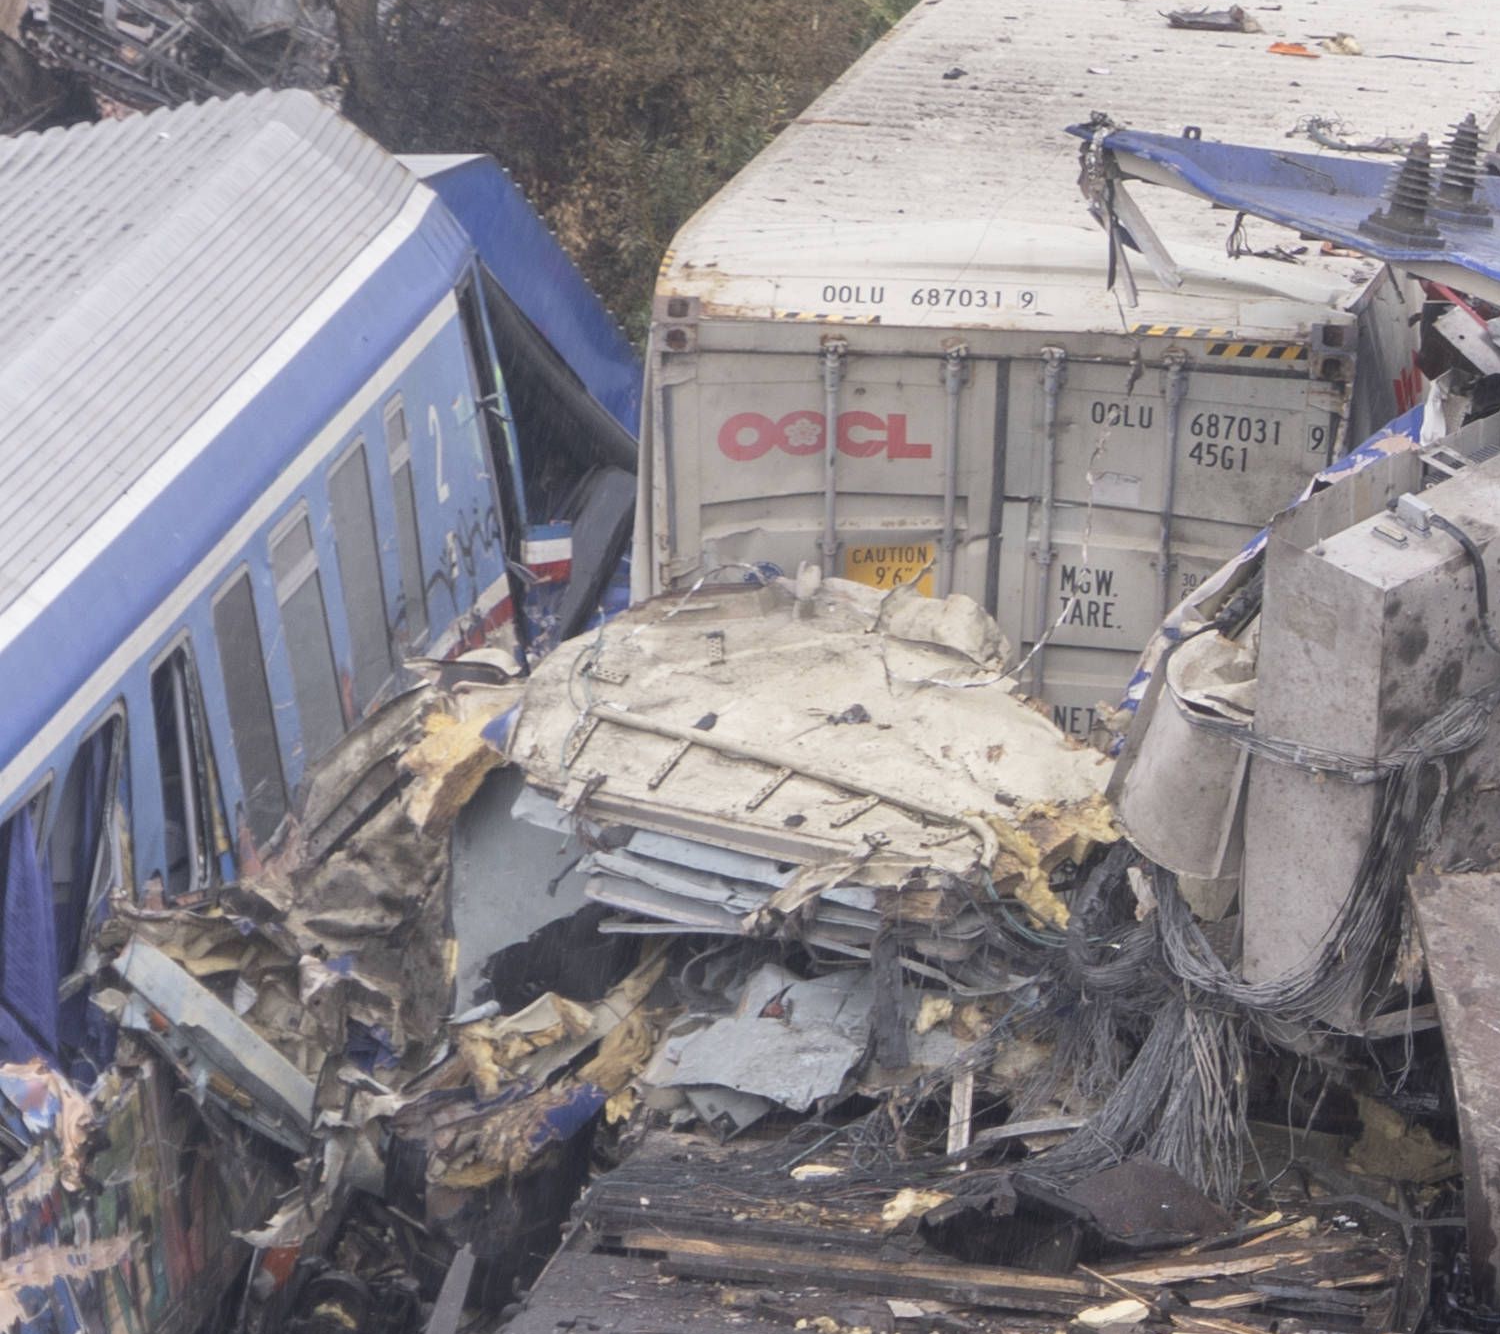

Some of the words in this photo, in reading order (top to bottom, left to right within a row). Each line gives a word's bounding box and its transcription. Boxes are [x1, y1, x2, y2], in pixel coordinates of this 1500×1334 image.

[821, 283, 885, 305] OOLU
[910, 287, 1002, 310] 687031
[1020, 290, 1035, 310] 9
[717, 410, 933, 461] OOCL
[1090, 399, 1153, 430] OOLU
[1190, 413, 1281, 445] 687031
[1310, 428, 1325, 451] 9
[428, 404, 450, 504] 2
[1189, 442, 1247, 472] 45G1
[852, 546, 927, 564] CAUTION
